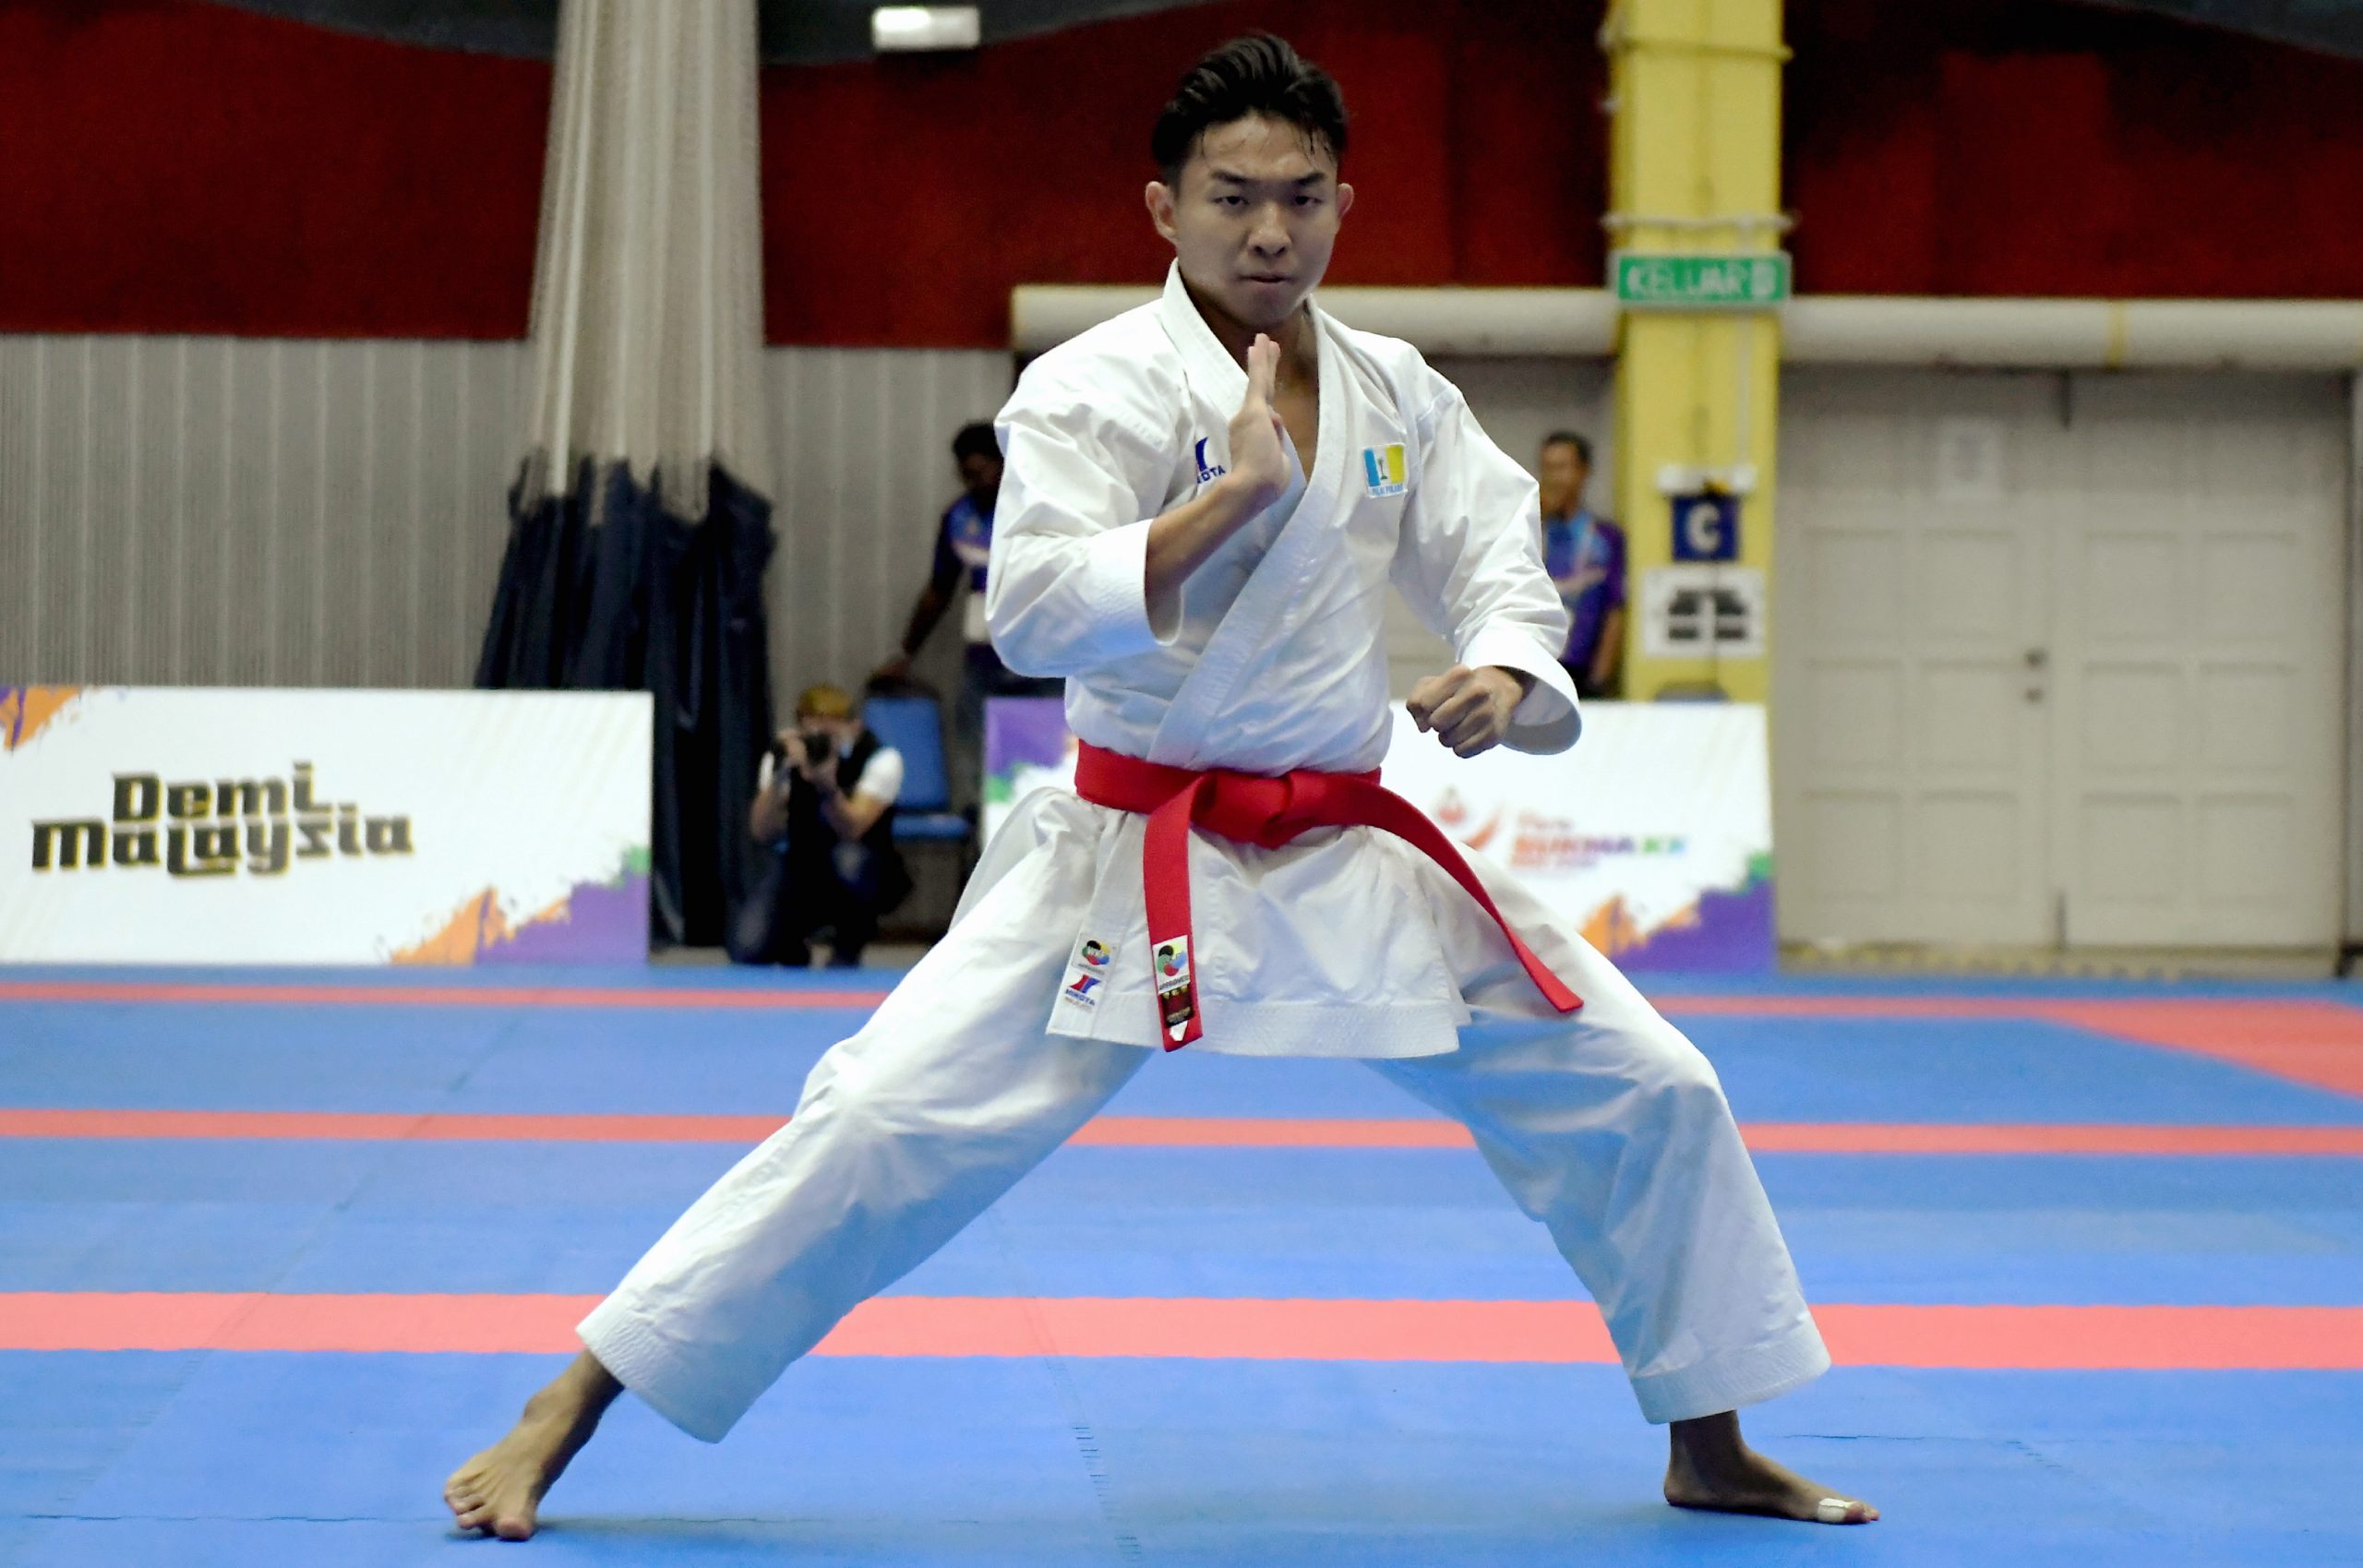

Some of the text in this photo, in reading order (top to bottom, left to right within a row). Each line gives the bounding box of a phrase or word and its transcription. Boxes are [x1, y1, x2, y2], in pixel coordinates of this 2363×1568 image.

[1626, 261, 1745, 296] KELUAR
[1686, 502, 1720, 553] C
[113, 759, 333, 821] Demi
